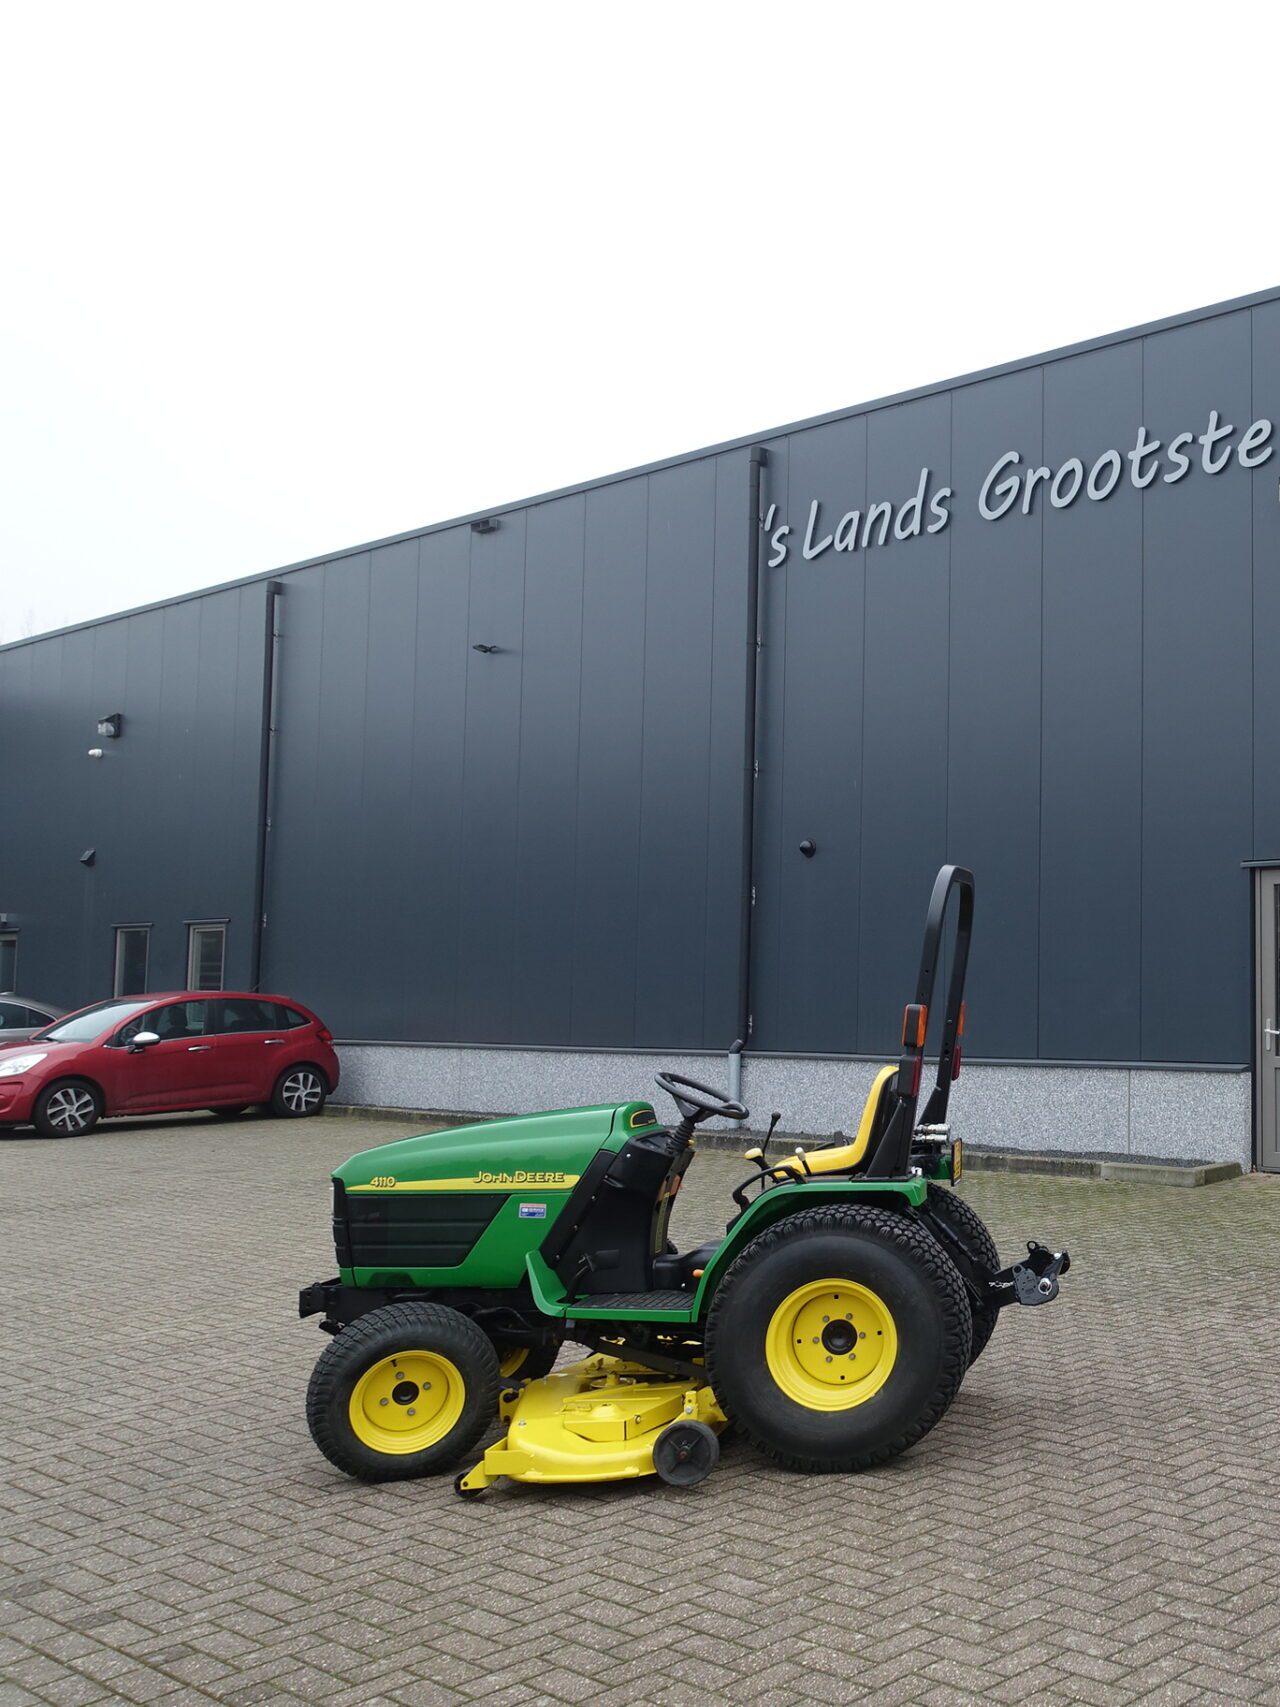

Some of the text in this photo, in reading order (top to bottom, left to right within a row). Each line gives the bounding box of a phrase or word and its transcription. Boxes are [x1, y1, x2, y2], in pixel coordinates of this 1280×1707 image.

[764, 503, 791, 569] 's
[802, 467, 952, 561] Lands
[978, 418, 1274, 521] Grootste
[370, 1176, 396, 1188] 4110
[473, 1170, 565, 1184] JOHN DEERE
